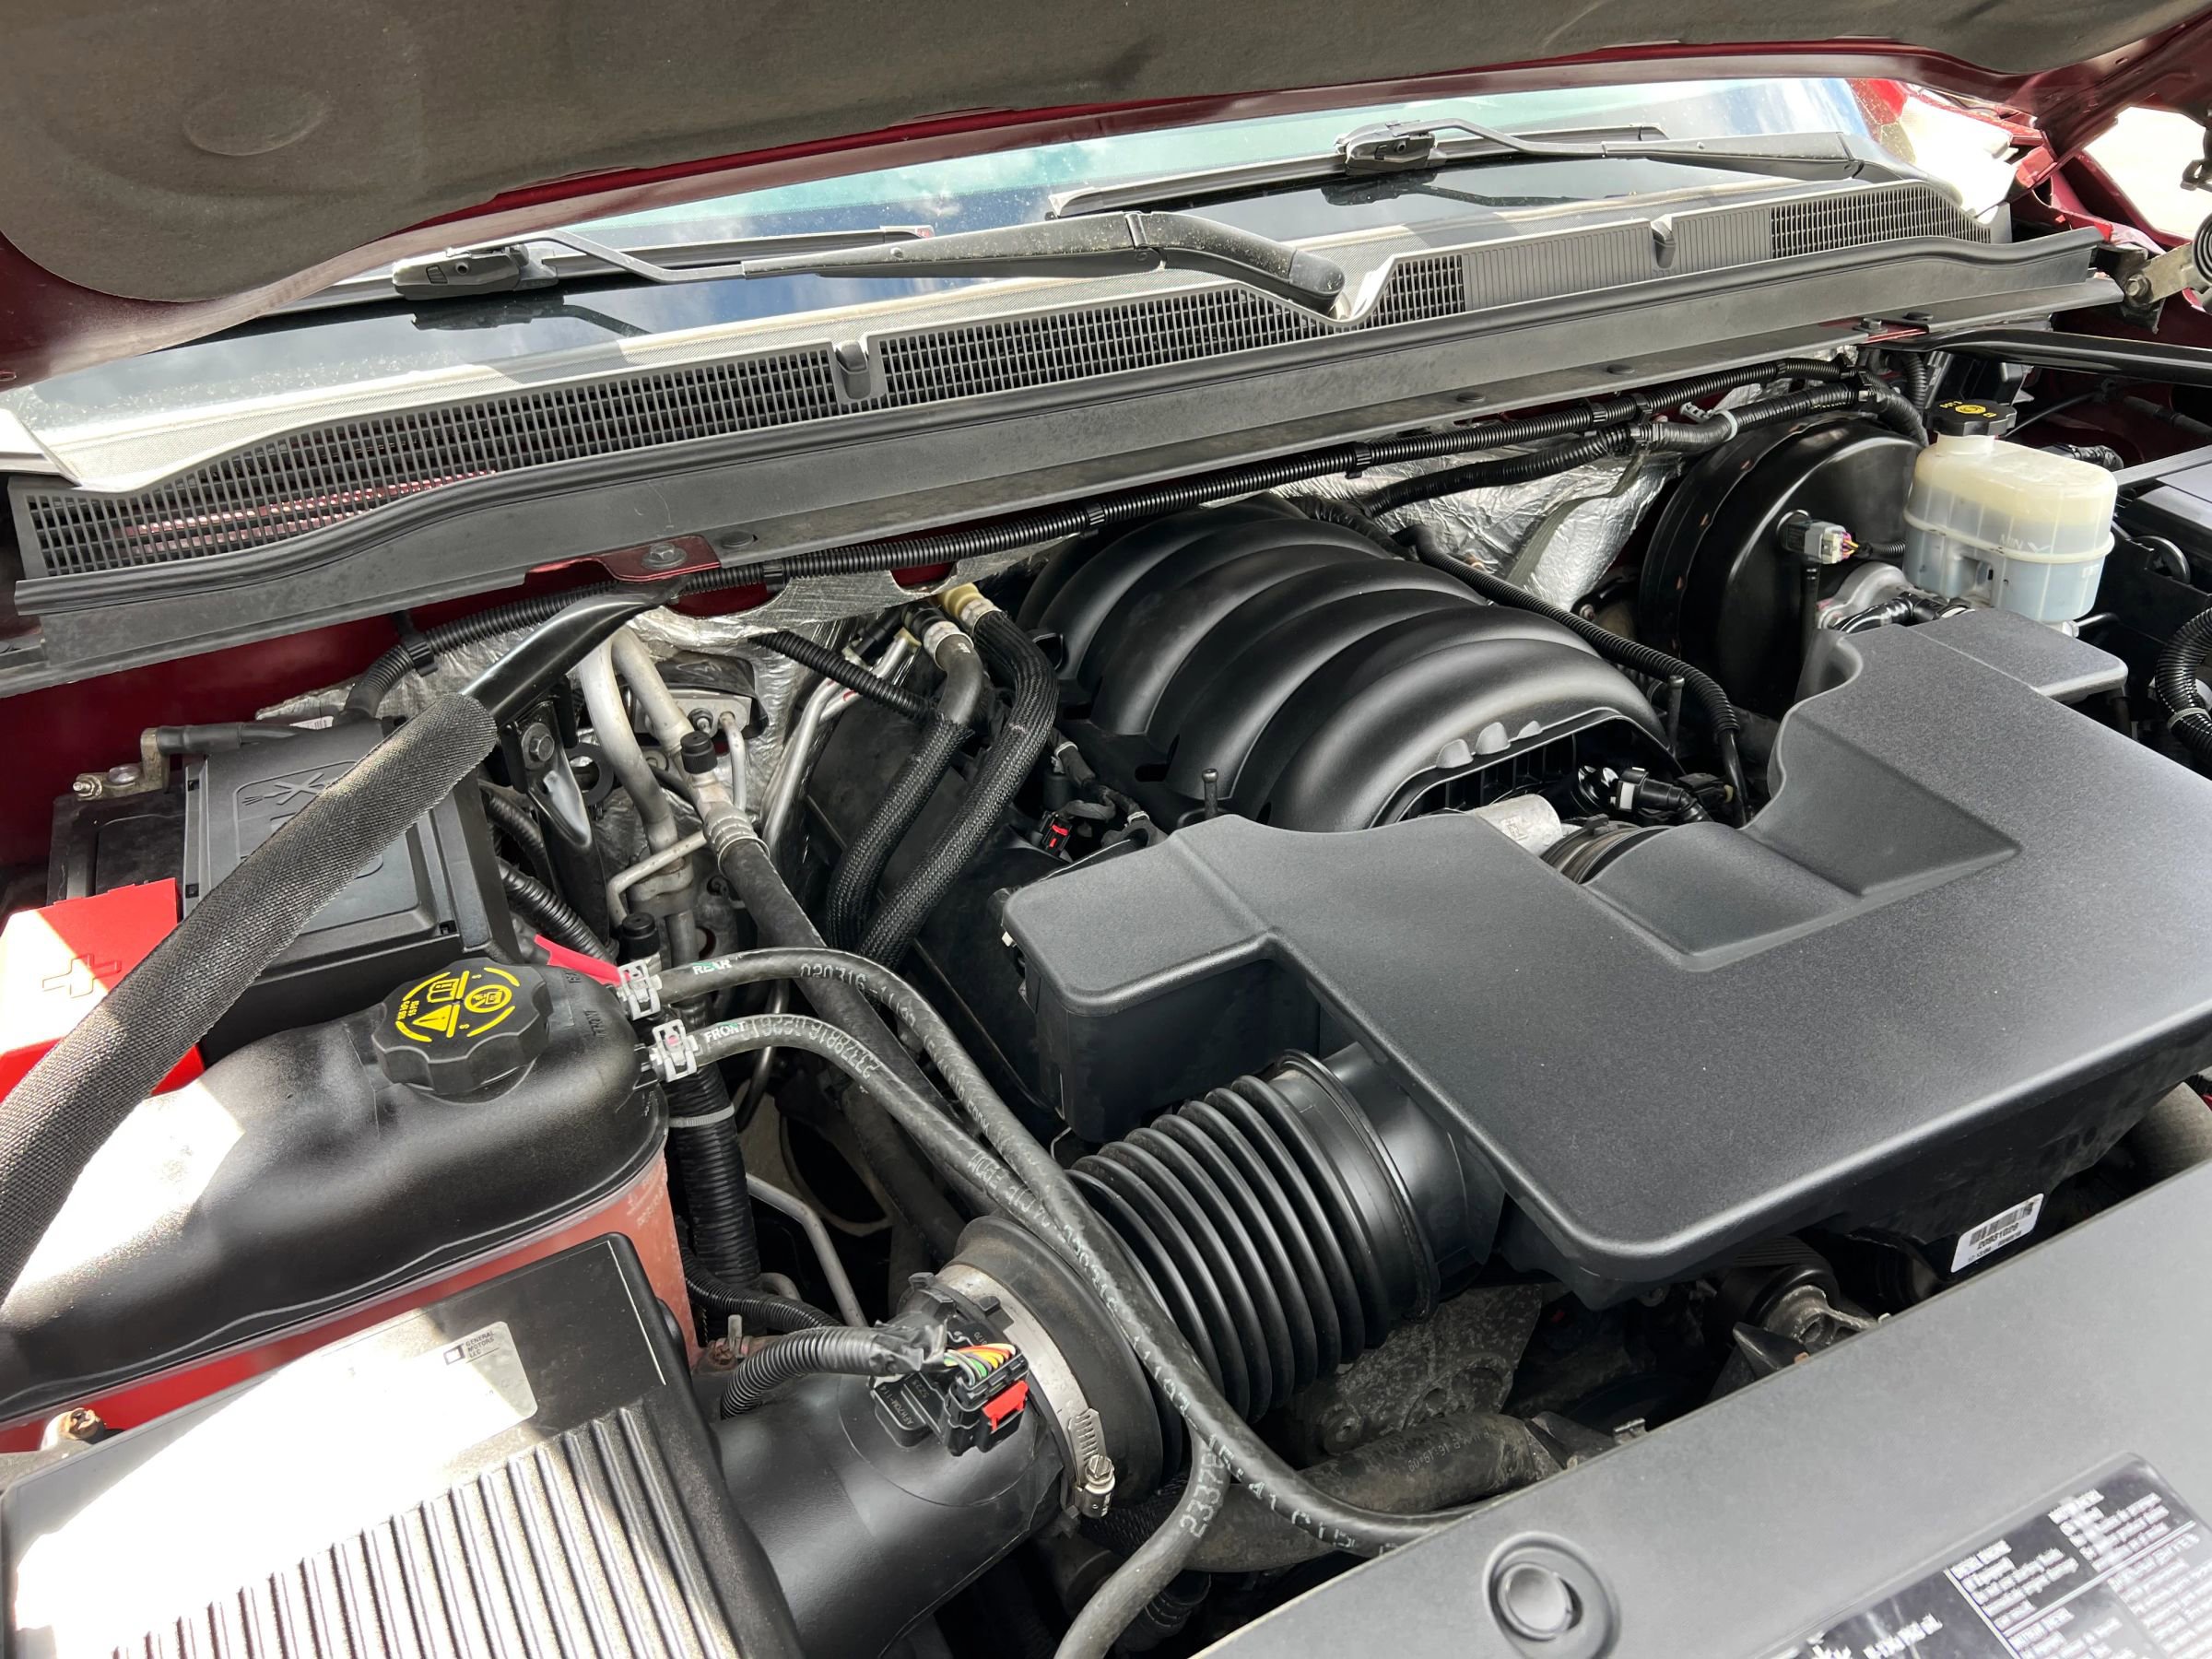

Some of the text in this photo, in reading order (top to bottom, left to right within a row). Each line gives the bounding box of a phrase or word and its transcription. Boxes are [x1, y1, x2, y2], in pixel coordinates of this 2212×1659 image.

[693, 958, 733, 975] REAR
[704, 1021, 746, 1043] FRONT
[465, 1330, 495, 1347] GENERAL
[467, 1337, 495, 1353] MOTORS
[469, 1349, 482, 1359] LLC
